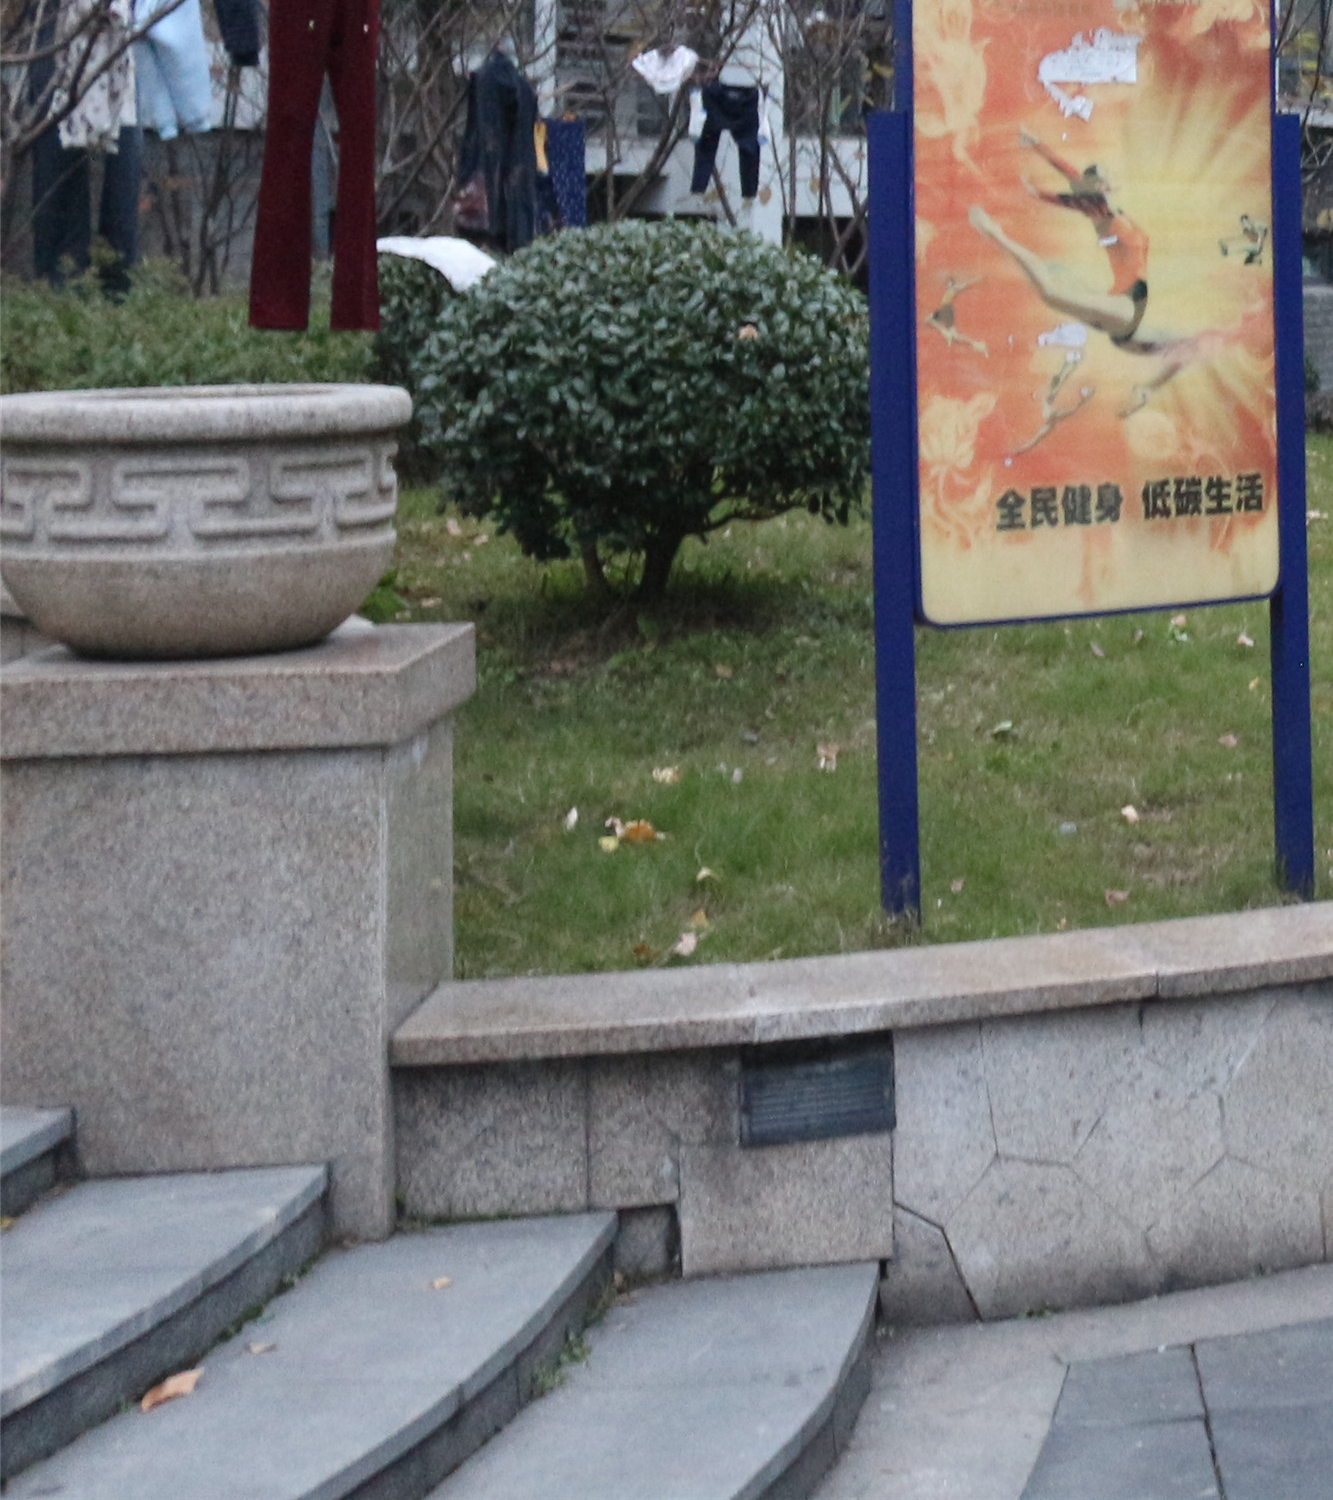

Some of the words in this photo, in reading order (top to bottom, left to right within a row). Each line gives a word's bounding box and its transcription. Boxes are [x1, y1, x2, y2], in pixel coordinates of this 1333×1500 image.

[996, 482, 1123, 531] 全民健身
[1142, 472, 1263, 520] 低碳生活
